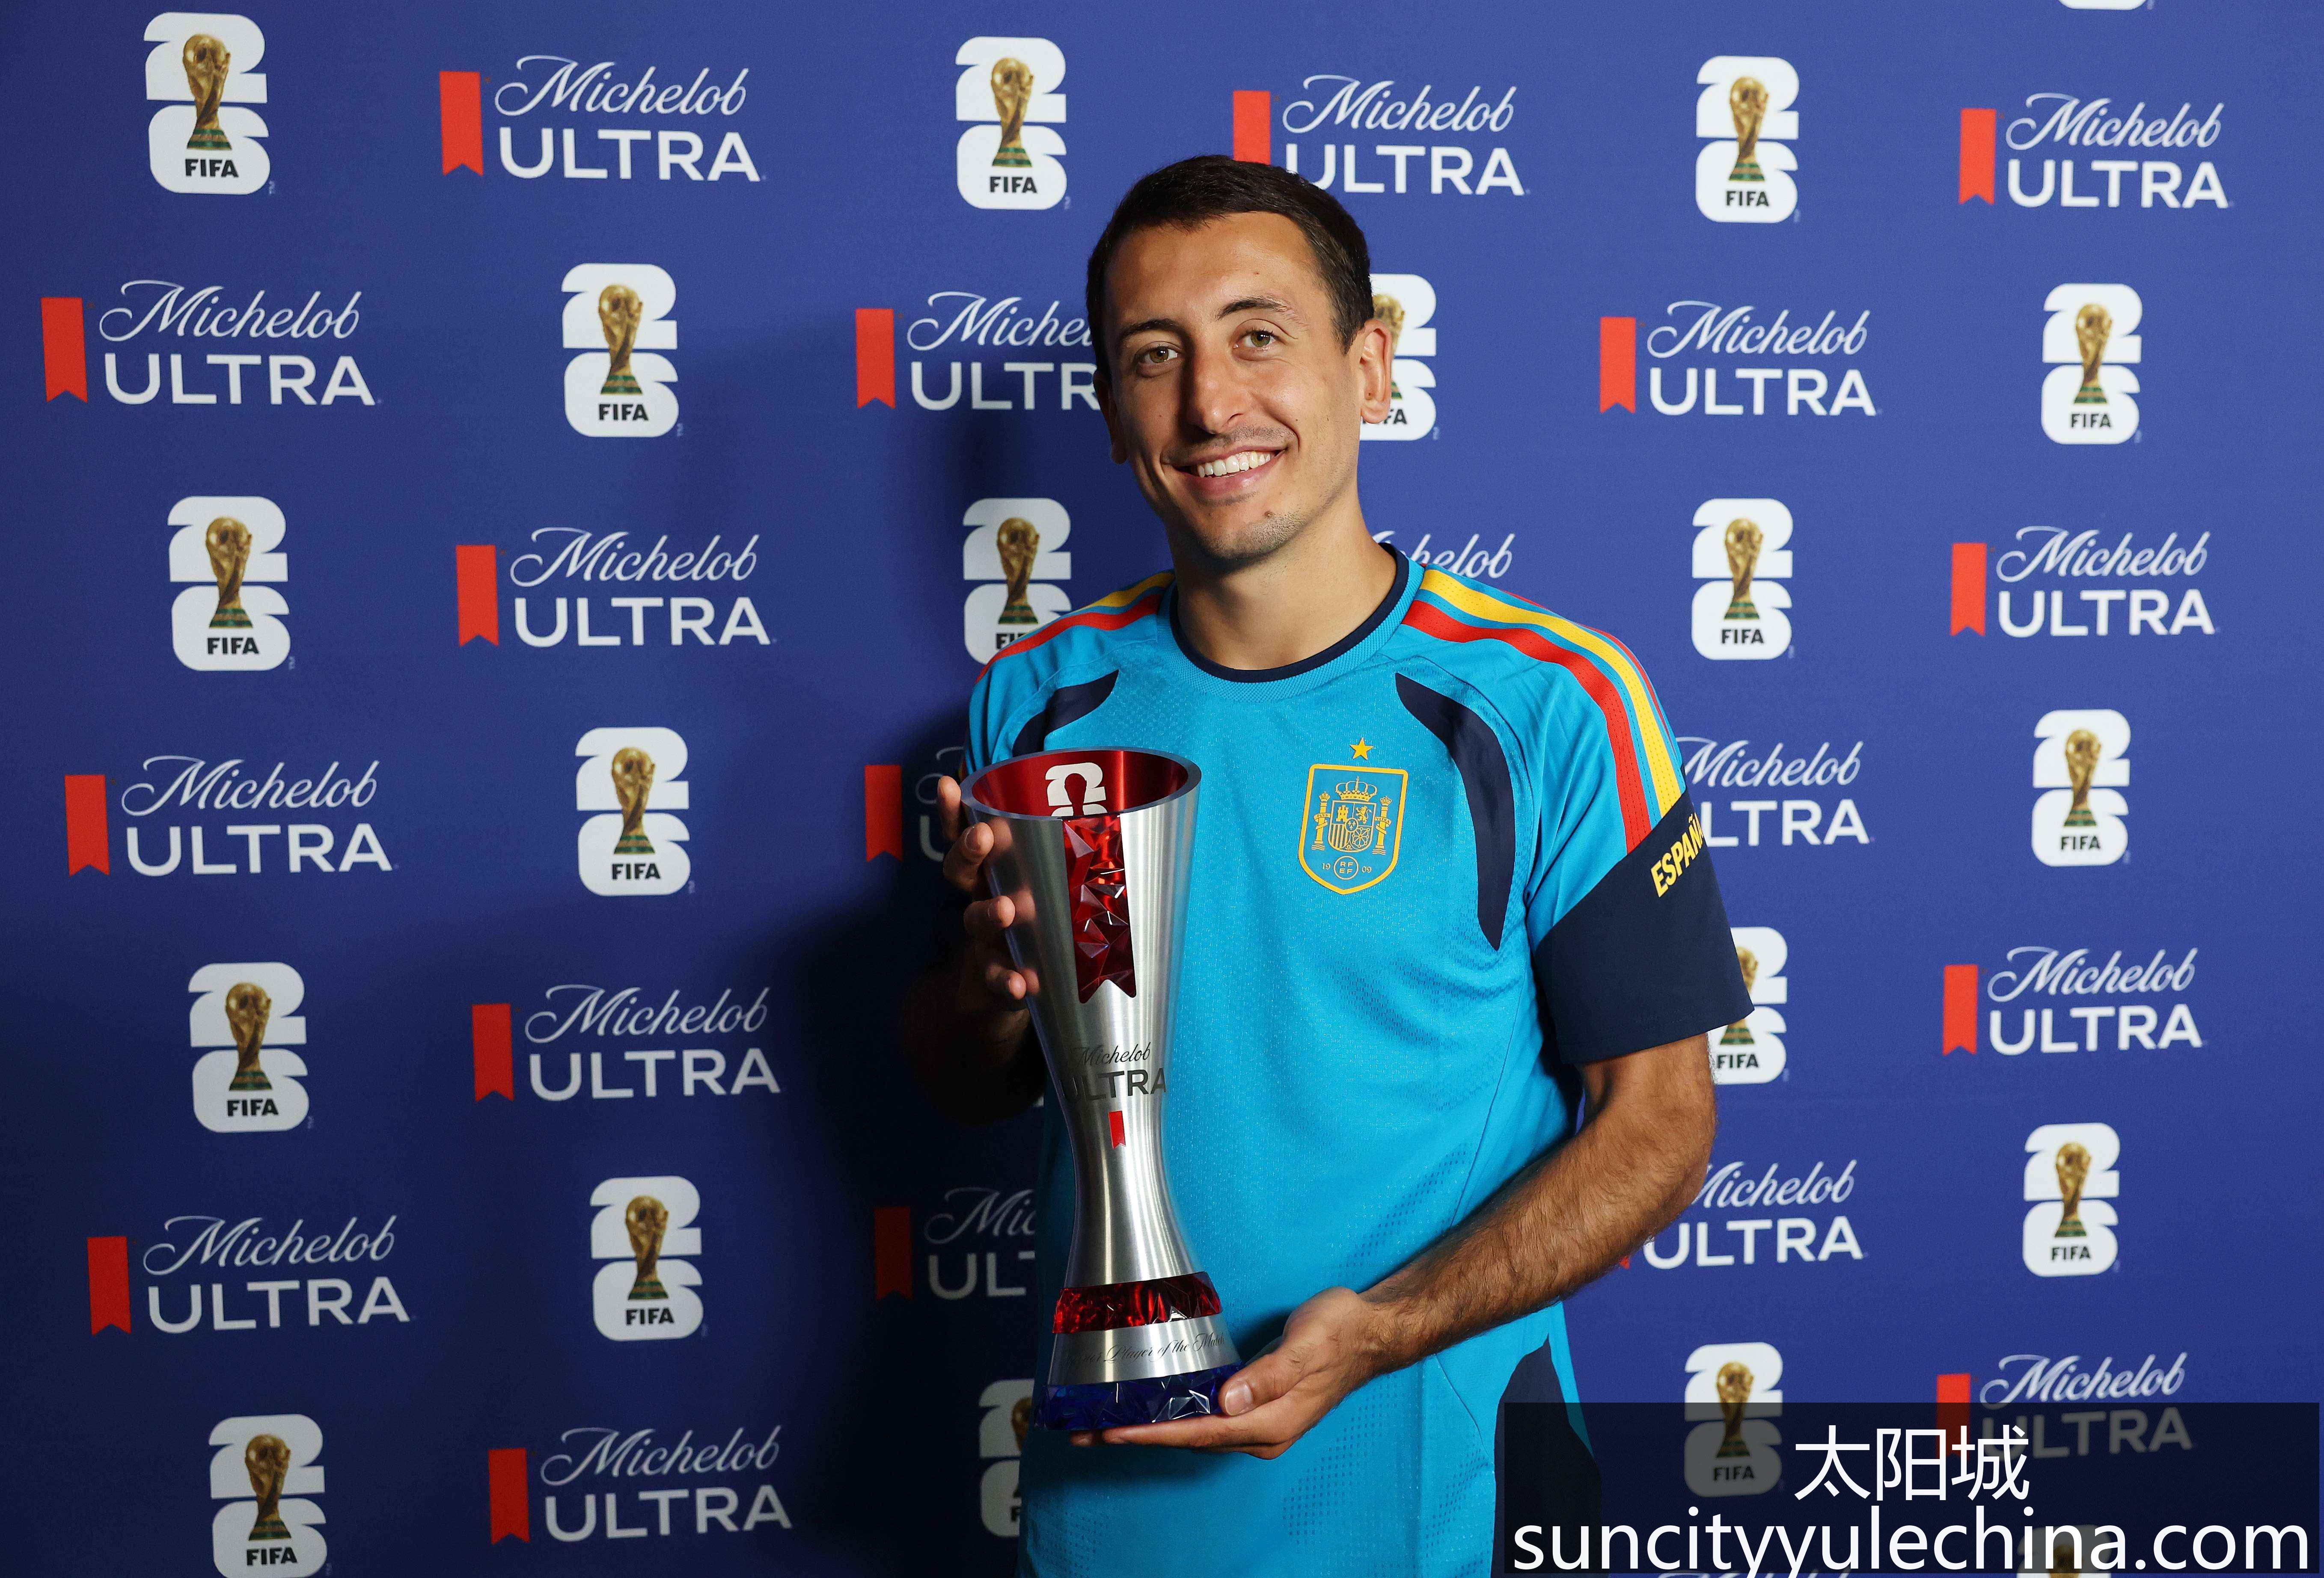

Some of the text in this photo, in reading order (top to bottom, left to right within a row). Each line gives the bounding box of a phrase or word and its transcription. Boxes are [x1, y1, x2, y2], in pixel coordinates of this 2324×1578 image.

[495, 56, 749, 116] Michelob
[1283, 75, 1516, 133] Michelob
[2006, 93, 2224, 150] Michelob
[185, 159, 238, 178] FIFA
[500, 128, 760, 181] ULTRA
[1285, 143, 1525, 196] ULTRA
[990, 176, 1037, 193] FIFA
[1726, 191, 1769, 207] FIFA
[2008, 159, 2228, 208] ULTRA
[99, 280, 361, 341] Michelob
[1647, 301, 1869, 358] Michelob
[105, 353, 375, 405] ULTRA
[911, 361, 1100, 411] ULTR
[1650, 368, 1876, 415] ULTRA
[599, 404, 648, 421] FIFA
[2071, 413, 2111, 428] FIFA
[510, 528, 759, 587] Michelob
[1997, 526, 2210, 582] Michelob
[515, 597, 770, 647] ULTRA
[1722, 629, 1764, 644] FIFA
[1999, 590, 2214, 637] ULTRA
[207, 638, 259, 654] FIFA
[122, 756, 379, 816] Michelob
[1701, 799, 1870, 847] LTRA
[2061, 836, 2101, 850] FIFA
[127, 824, 392, 876] ULTRA
[612, 863, 660, 880] FIFA
[1988, 946, 2197, 1002] Michelob
[525, 985, 768, 1043] Michelob
[1990, 1004, 2202, 1055] ULTRA
[530, 1049, 779, 1100] ULTRA
[1060, 1068, 1166, 1103] ULTRA
[1717, 1053, 1759, 1068] FIFA
[227, 1099, 279, 1117] FIFA
[143, 1215, 396, 1275] Michelob
[1643, 1216, 1863, 1270] ULTRA
[2052, 1246, 2091, 1261] FIFA
[149, 1277, 409, 1333] ULTRA
[626, 1308, 674, 1325] FIFA
[1172, 1340, 1190, 1353] the
[1979, 1353, 2187, 1409] Michelob
[541, 1426, 780, 1486] Michelob
[1713, 1465, 1755, 1482] FIFA
[546, 1486, 790, 1541] ULTRA
[246, 1547, 298, 1566] FIFA
